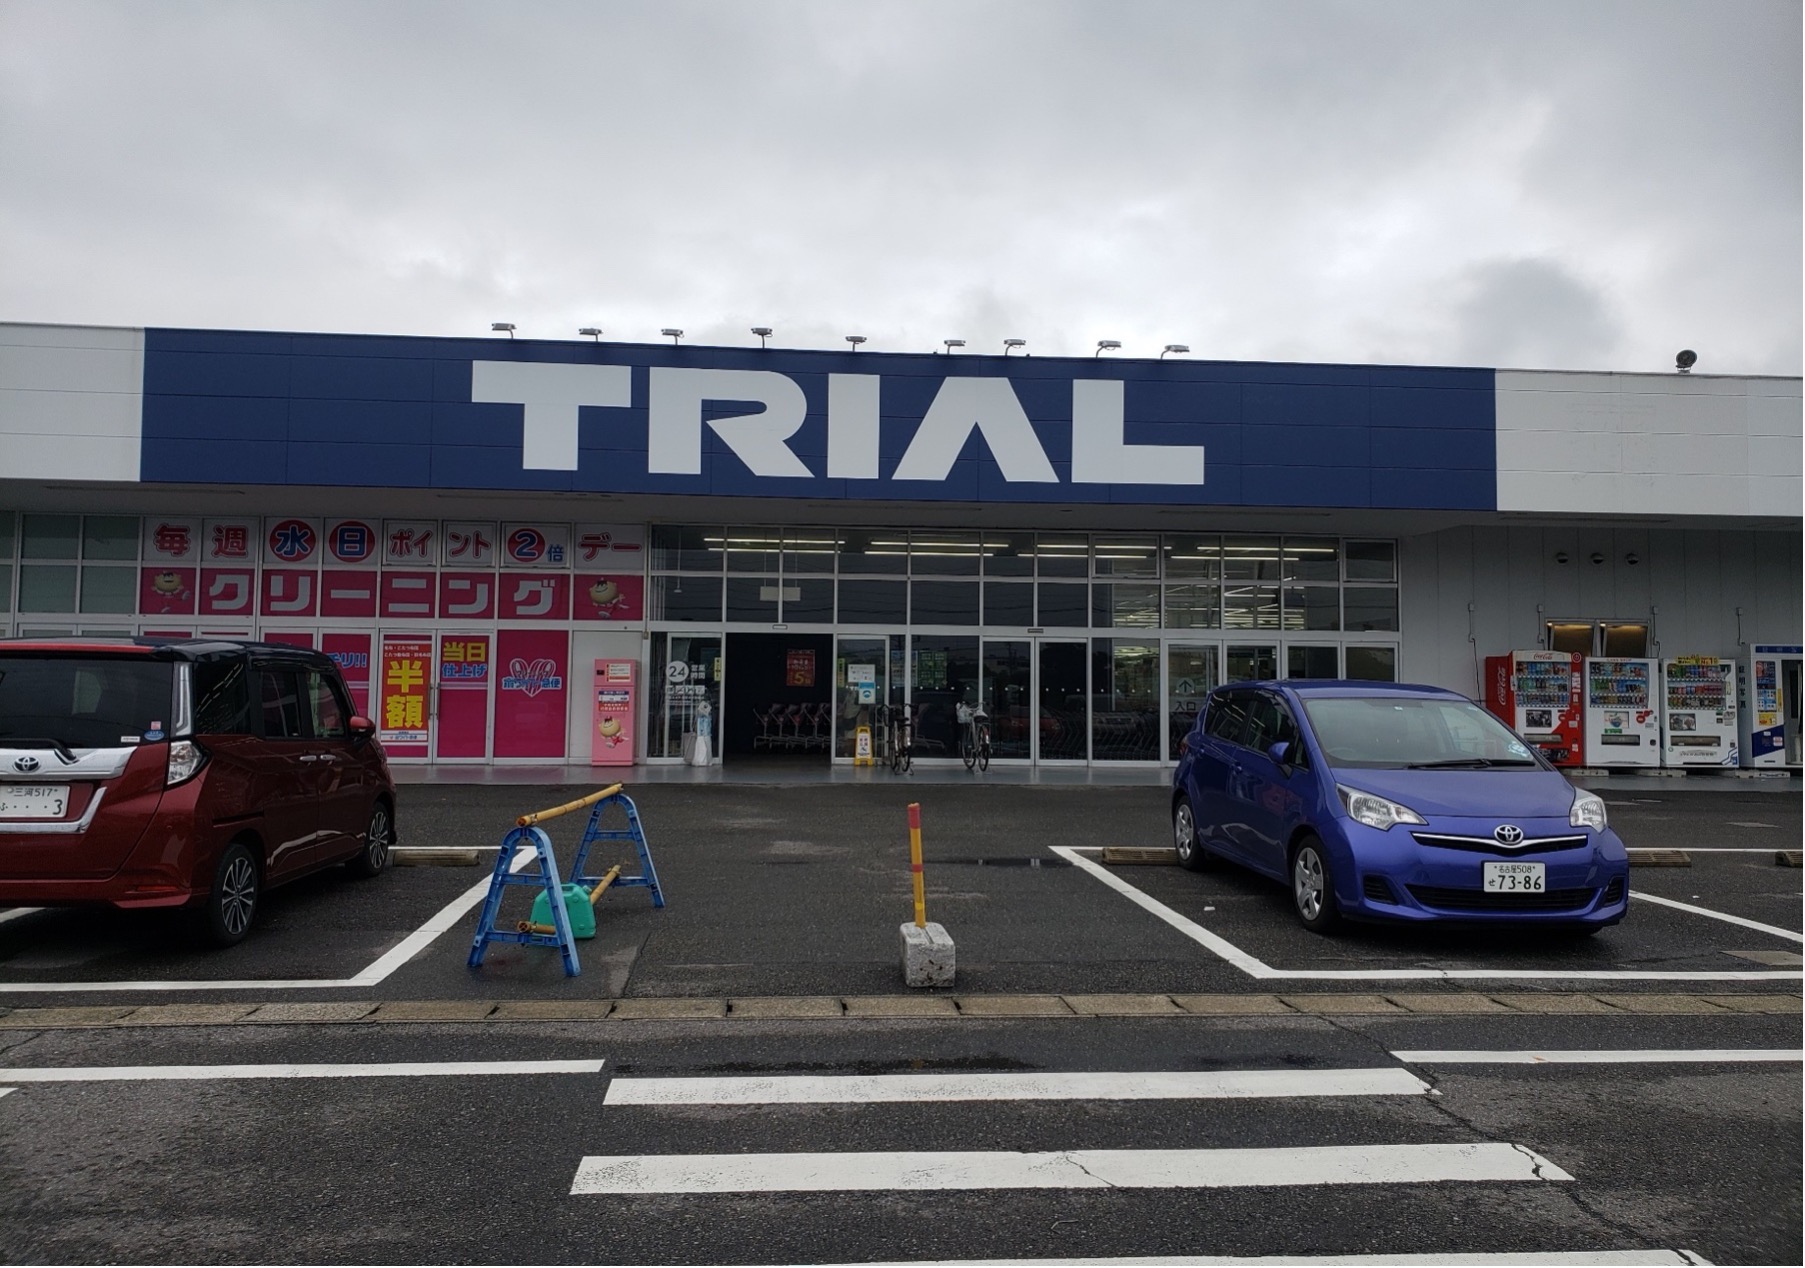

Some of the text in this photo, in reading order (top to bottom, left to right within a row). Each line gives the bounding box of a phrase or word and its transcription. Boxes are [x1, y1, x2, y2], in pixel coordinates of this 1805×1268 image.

[472, 360, 1205, 485] TRIAL
[208, 574, 557, 616] クリーニング
[443, 642, 486, 662] 当日
[442, 663, 487, 678] 仕上げ
[669, 666, 686, 677] 24
[386, 660, 424, 729] 半額
[1175, 701, 1196, 711] 入口
[1498, 875, 1542, 890] 73-86
